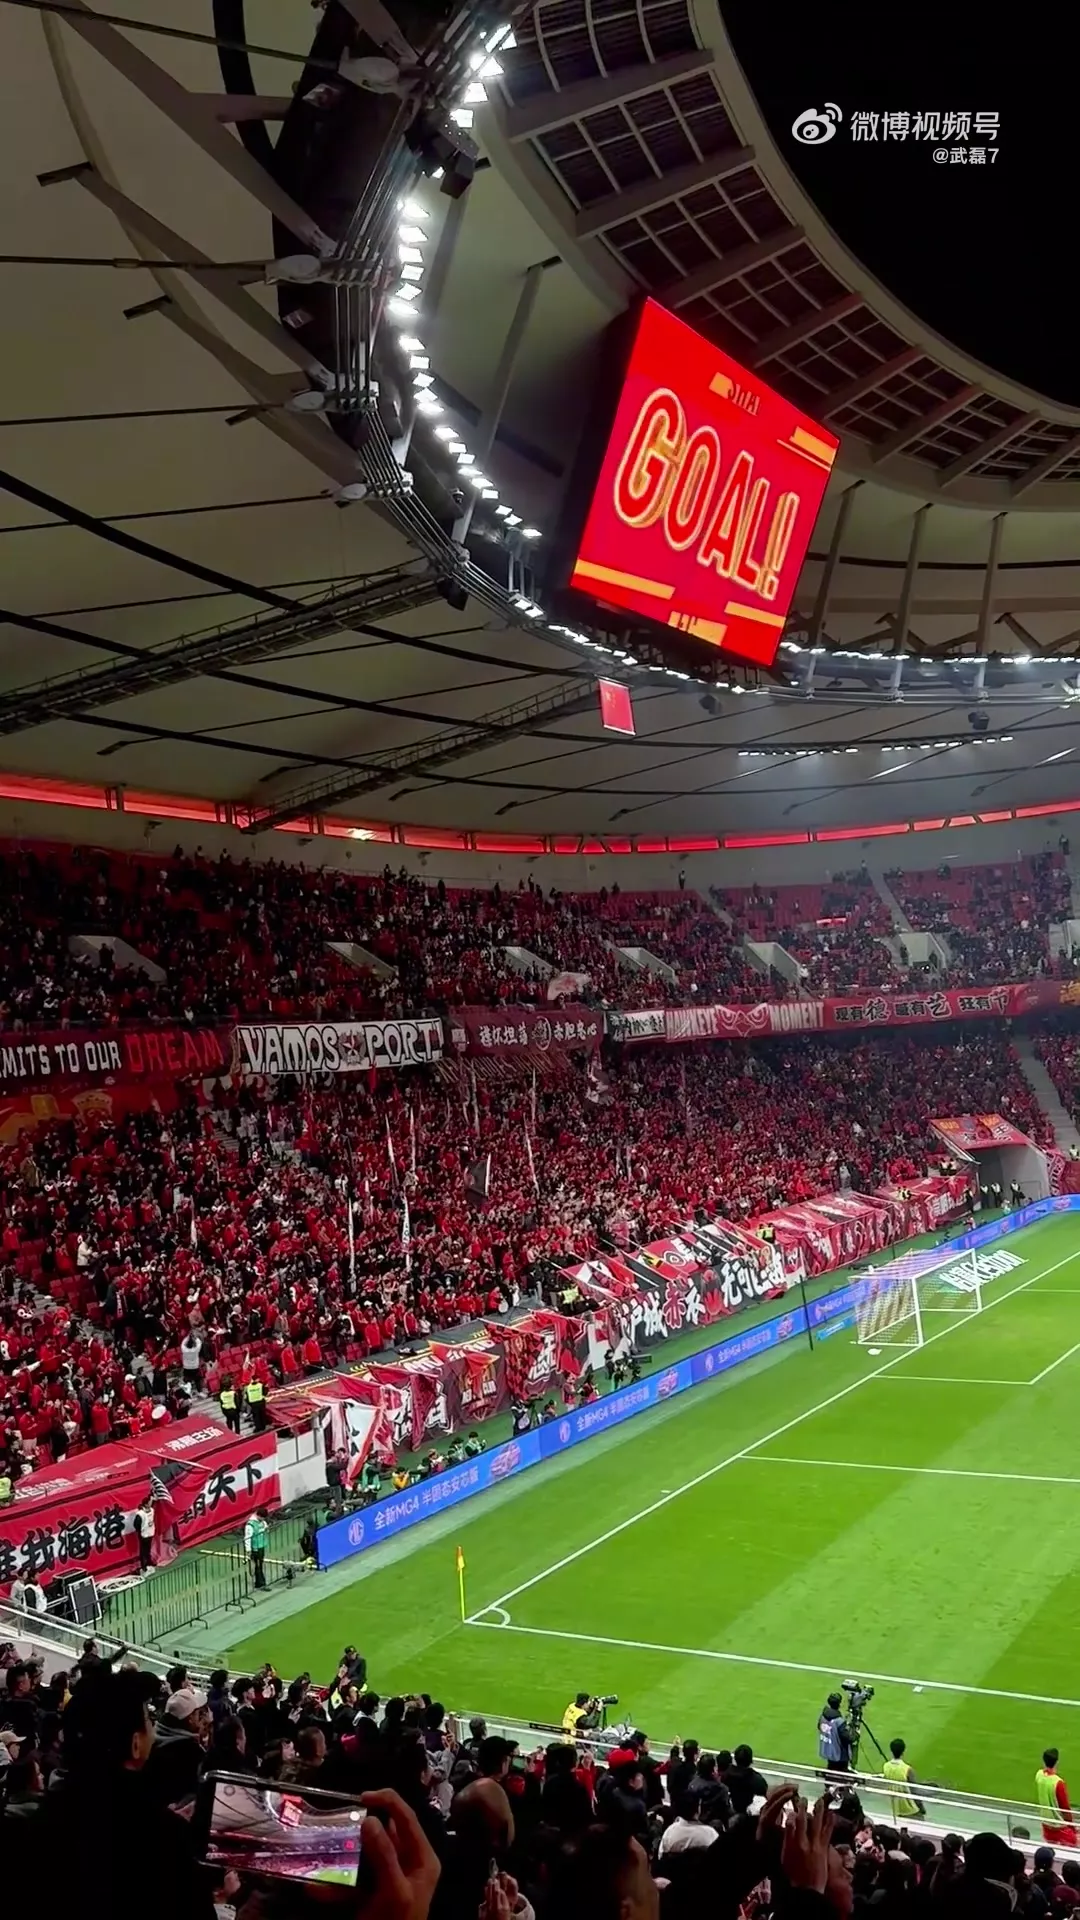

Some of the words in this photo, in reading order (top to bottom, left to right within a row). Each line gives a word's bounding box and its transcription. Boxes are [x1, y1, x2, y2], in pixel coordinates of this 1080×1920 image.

[769, 1002, 824, 1031] MOMENT
[0, 1044, 51, 1078] MITS
[54, 1042, 79, 1073] TO
[84, 1040, 122, 1071] OUR
[125, 1030, 225, 1072] DREAM
[240, 1025, 340, 1074] VAMOS
[374, 1495, 420, 1531] 全新MG4
